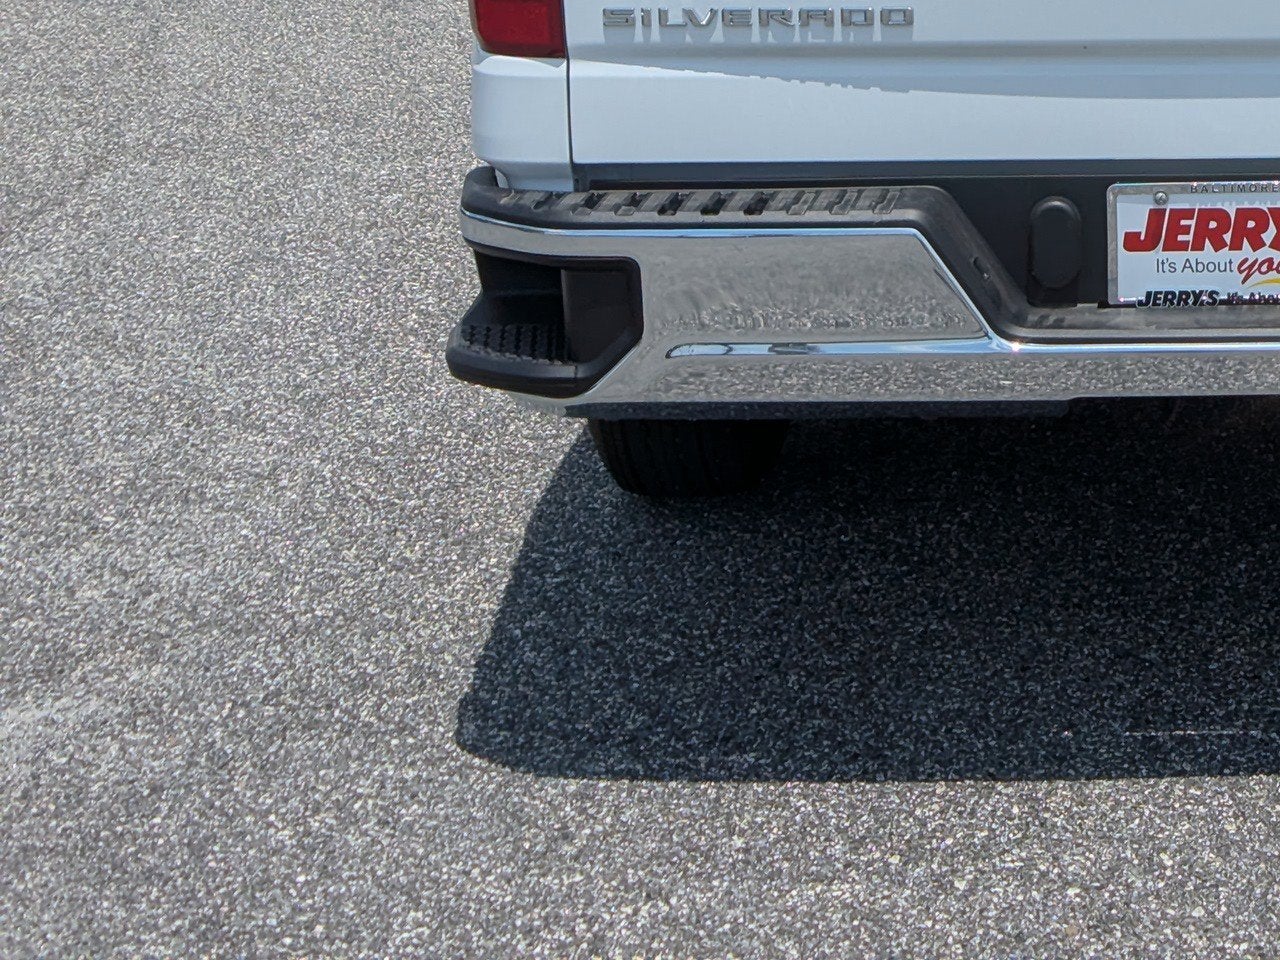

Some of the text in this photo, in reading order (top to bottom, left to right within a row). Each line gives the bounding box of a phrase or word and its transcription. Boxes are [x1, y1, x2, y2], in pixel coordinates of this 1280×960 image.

[602, 7, 914, 28] SILVERADO
[1190, 183, 1280, 193] BALTIMORE
[1155, 257, 1177, 274] It's
[1181, 257, 1234, 274] About
[1135, 290, 1220, 308] JERRY'S
